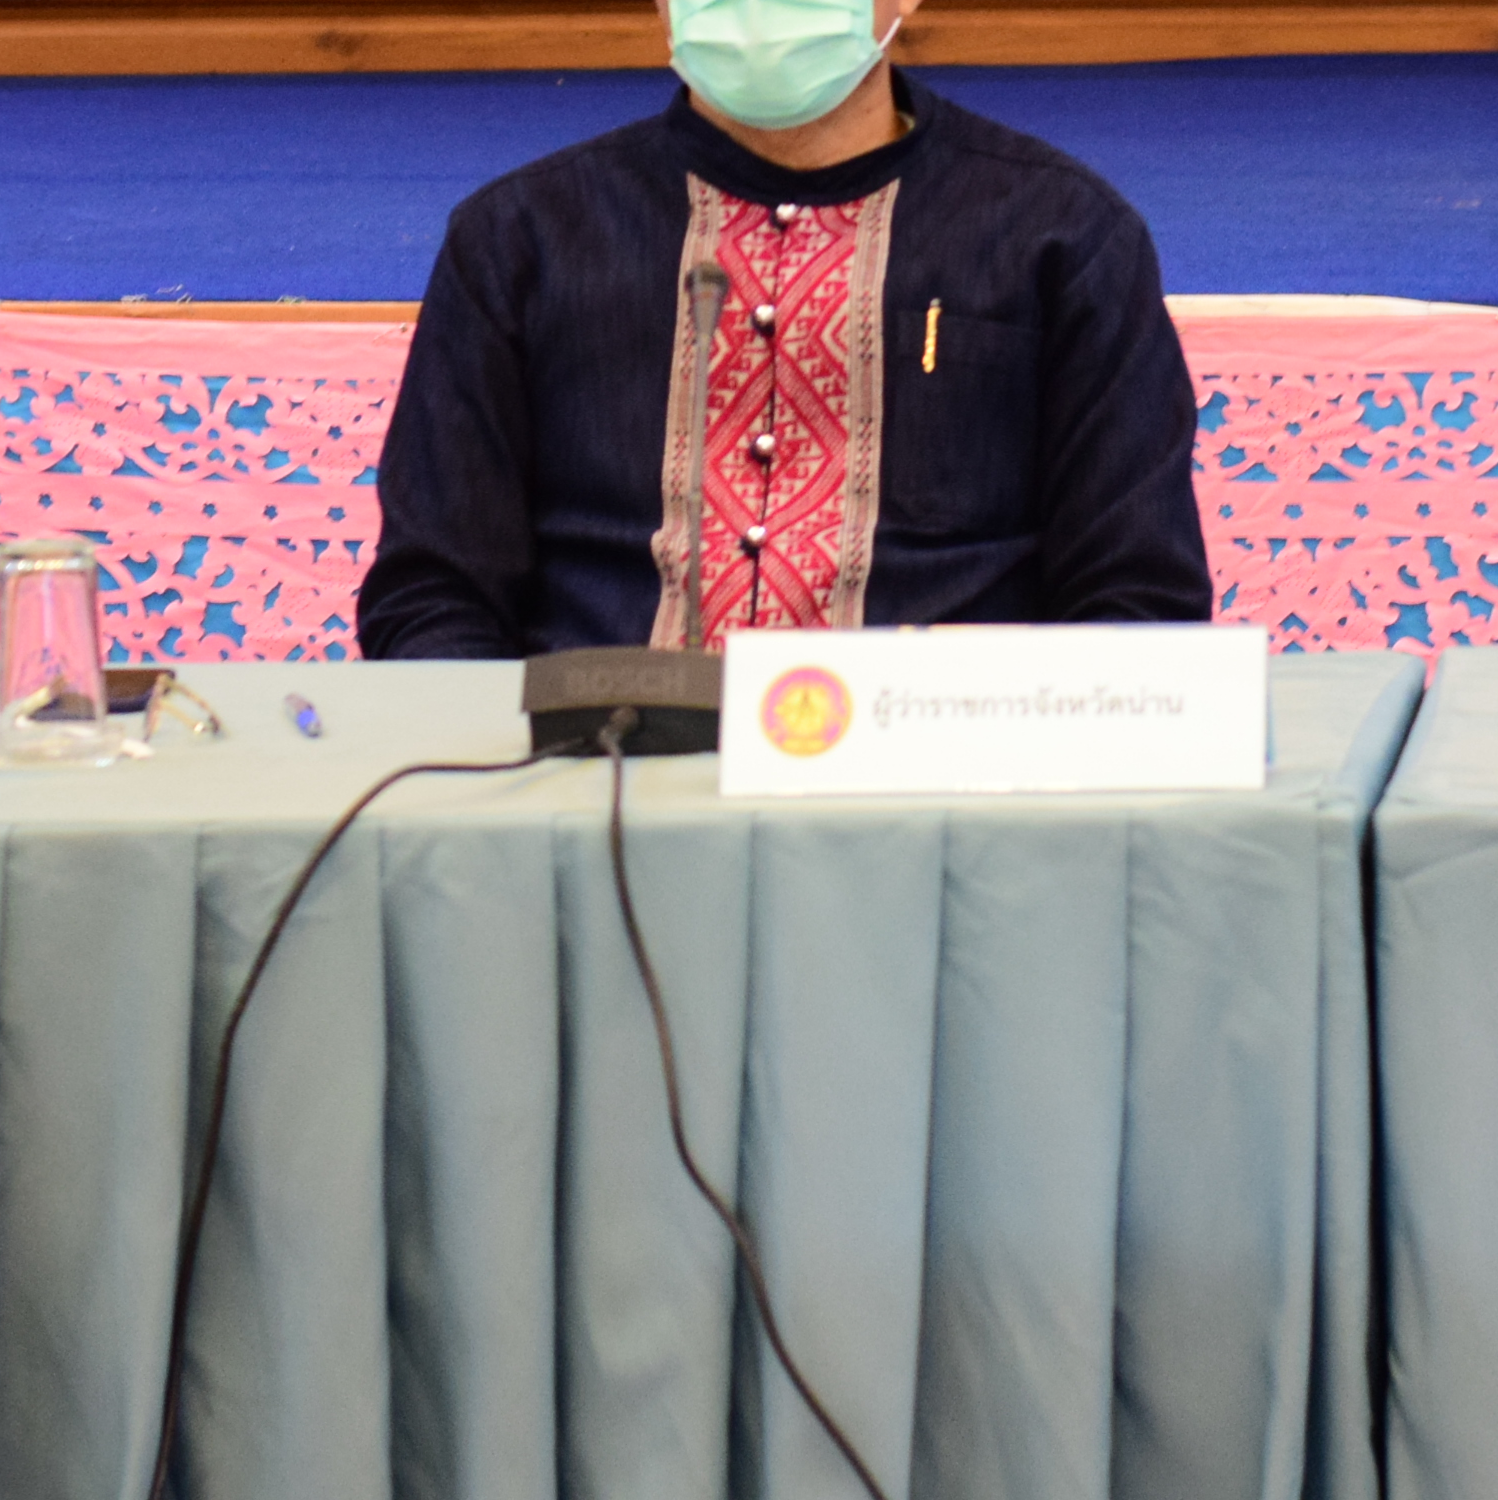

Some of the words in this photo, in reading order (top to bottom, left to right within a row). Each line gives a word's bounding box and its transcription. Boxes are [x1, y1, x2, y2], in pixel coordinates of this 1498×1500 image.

[871, 686, 1186, 730] ผู้ว่าราชการจังหวัดน่าน
